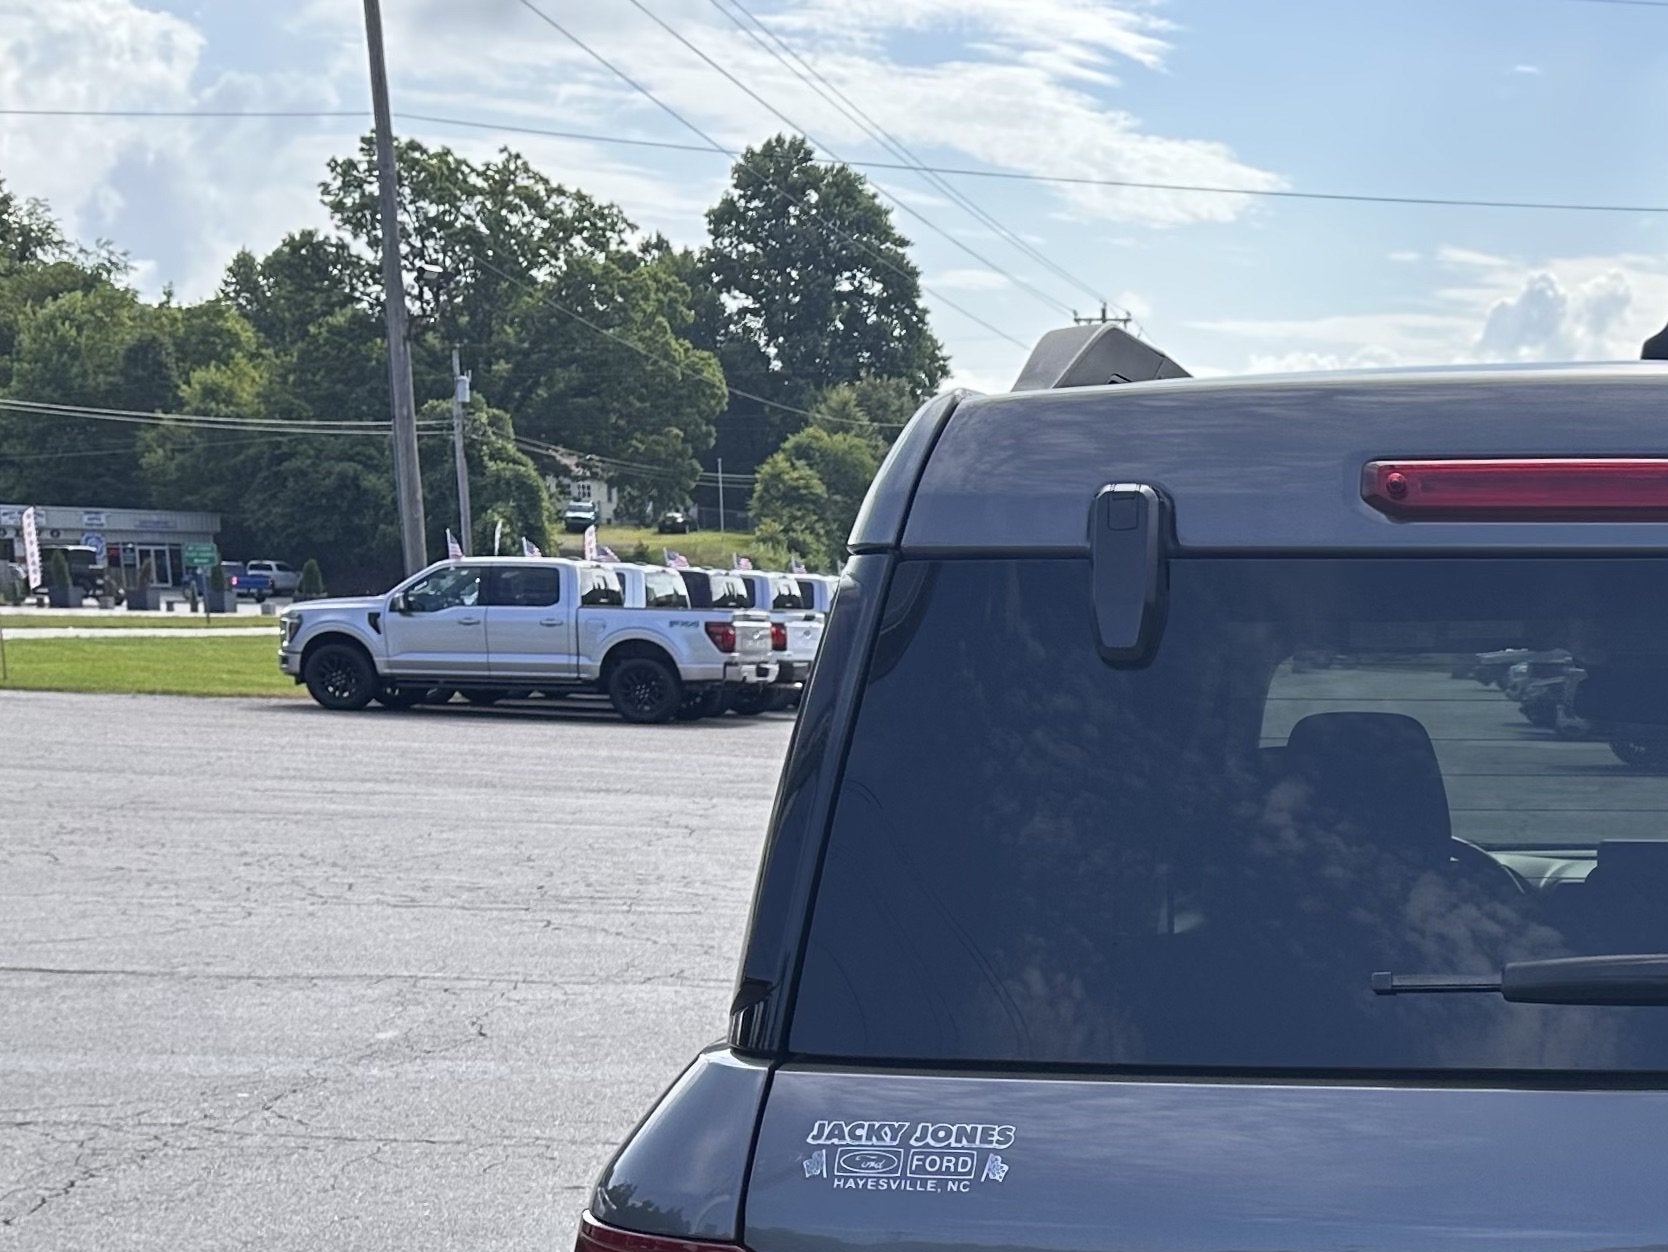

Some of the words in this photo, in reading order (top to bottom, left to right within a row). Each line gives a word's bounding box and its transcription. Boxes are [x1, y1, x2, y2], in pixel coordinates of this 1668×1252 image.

[807, 1120, 910, 1145] JACKY
[910, 1123, 1016, 1149] JONES
[911, 1155, 972, 1173] FORD
[833, 1177, 942, 1193] HAYESVILLE,
[947, 1180, 971, 1192] NC
